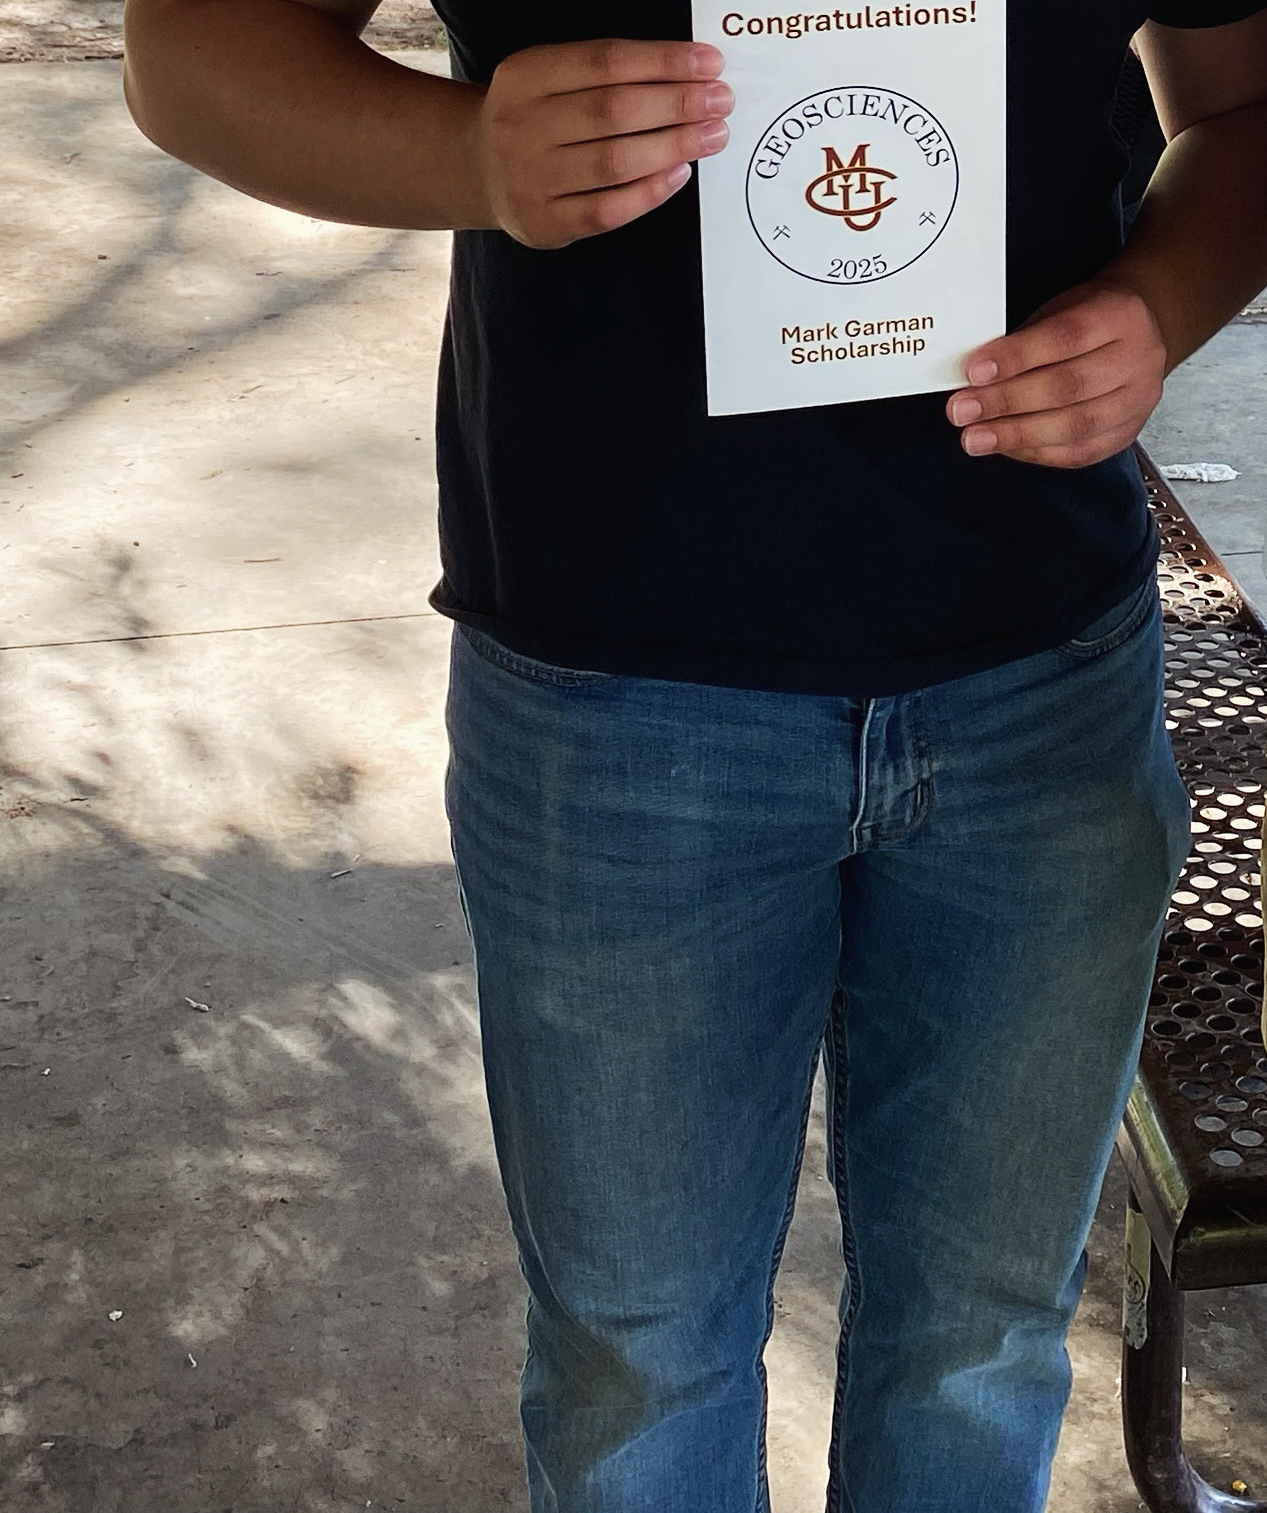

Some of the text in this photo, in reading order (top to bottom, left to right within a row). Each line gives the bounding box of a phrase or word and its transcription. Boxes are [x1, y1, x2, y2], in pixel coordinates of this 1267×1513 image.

[721, 0, 977, 40] Congratulations!
[754, 93, 951, 181] GEOSCIENCES
[826, 253, 888, 280] 2025
[780, 316, 935, 345] Mark Garman
[790, 336, 926, 365] Scholarship
